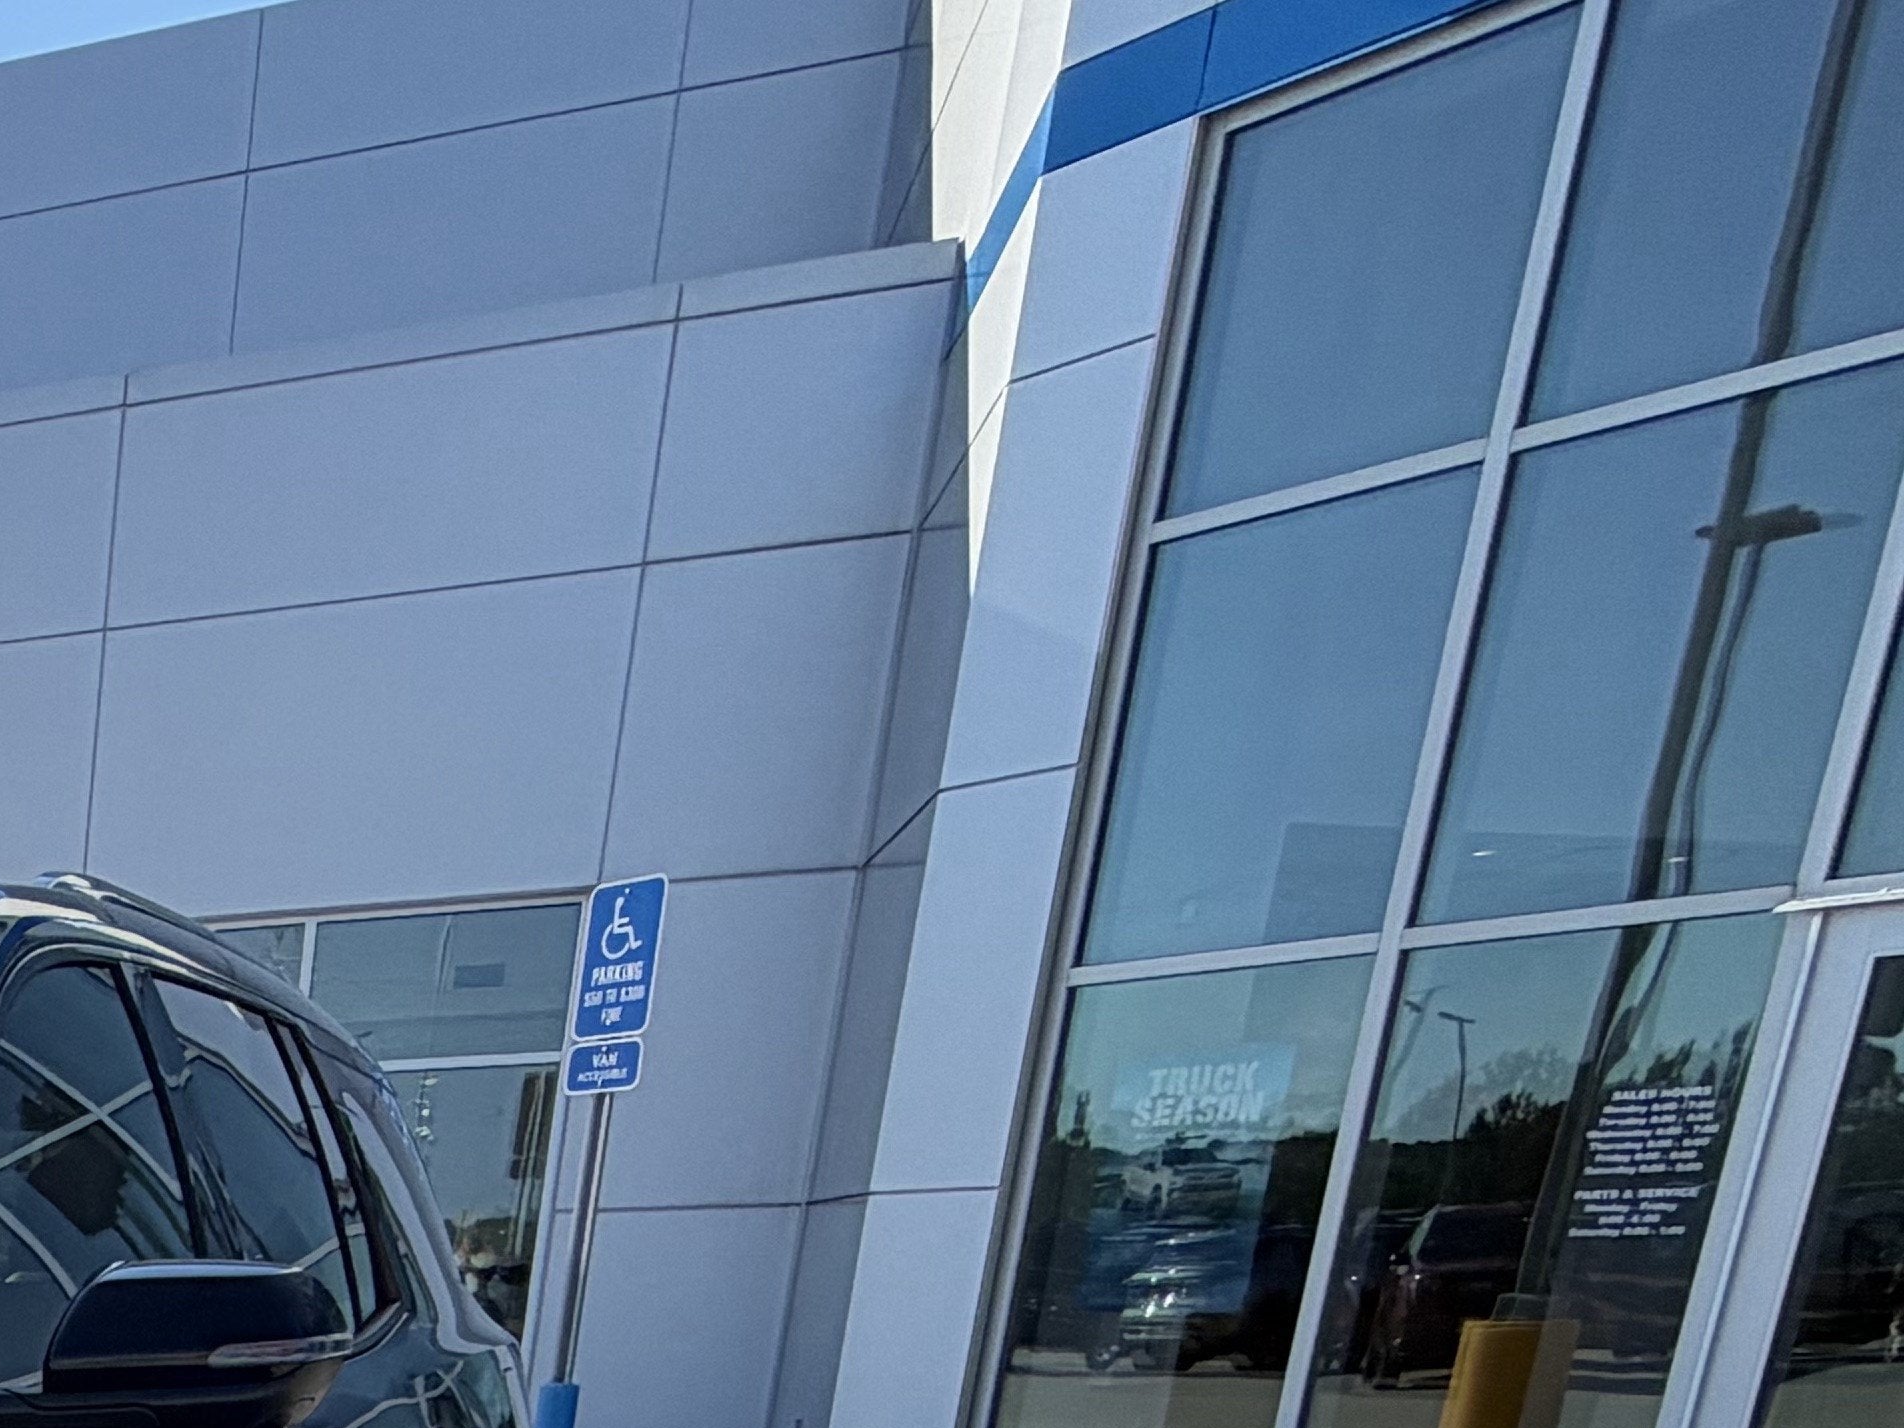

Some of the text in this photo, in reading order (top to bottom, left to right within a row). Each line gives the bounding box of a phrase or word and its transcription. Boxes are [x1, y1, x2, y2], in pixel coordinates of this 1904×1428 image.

[591, 961, 644, 987] PARKING
[593, 1051, 618, 1068] VAN
[1149, 1061, 1259, 1097] TRUCK
[1130, 1091, 1263, 1127] SEASON
